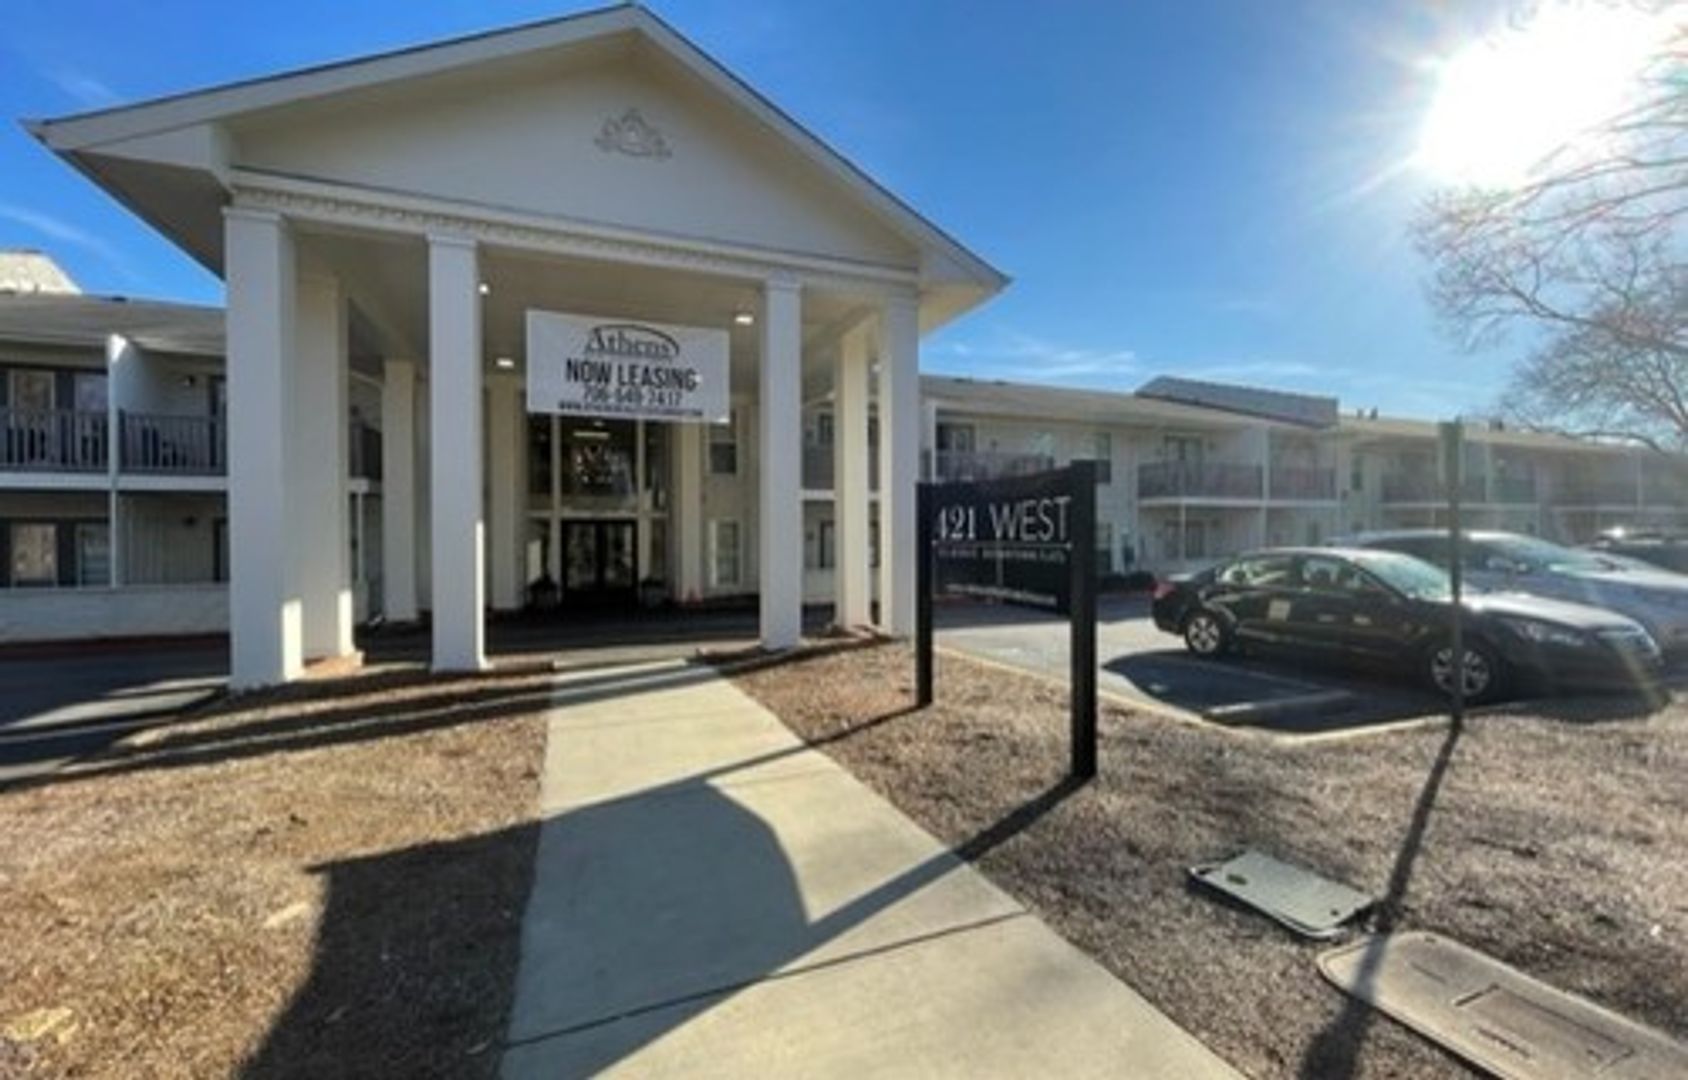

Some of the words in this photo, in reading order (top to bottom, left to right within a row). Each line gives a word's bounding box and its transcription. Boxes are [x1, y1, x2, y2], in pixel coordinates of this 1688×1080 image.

[584, 326, 673, 361] Athens
[566, 357, 611, 384] NOW
[617, 364, 698, 391] LEASING
[988, 495, 1072, 541] WEST
